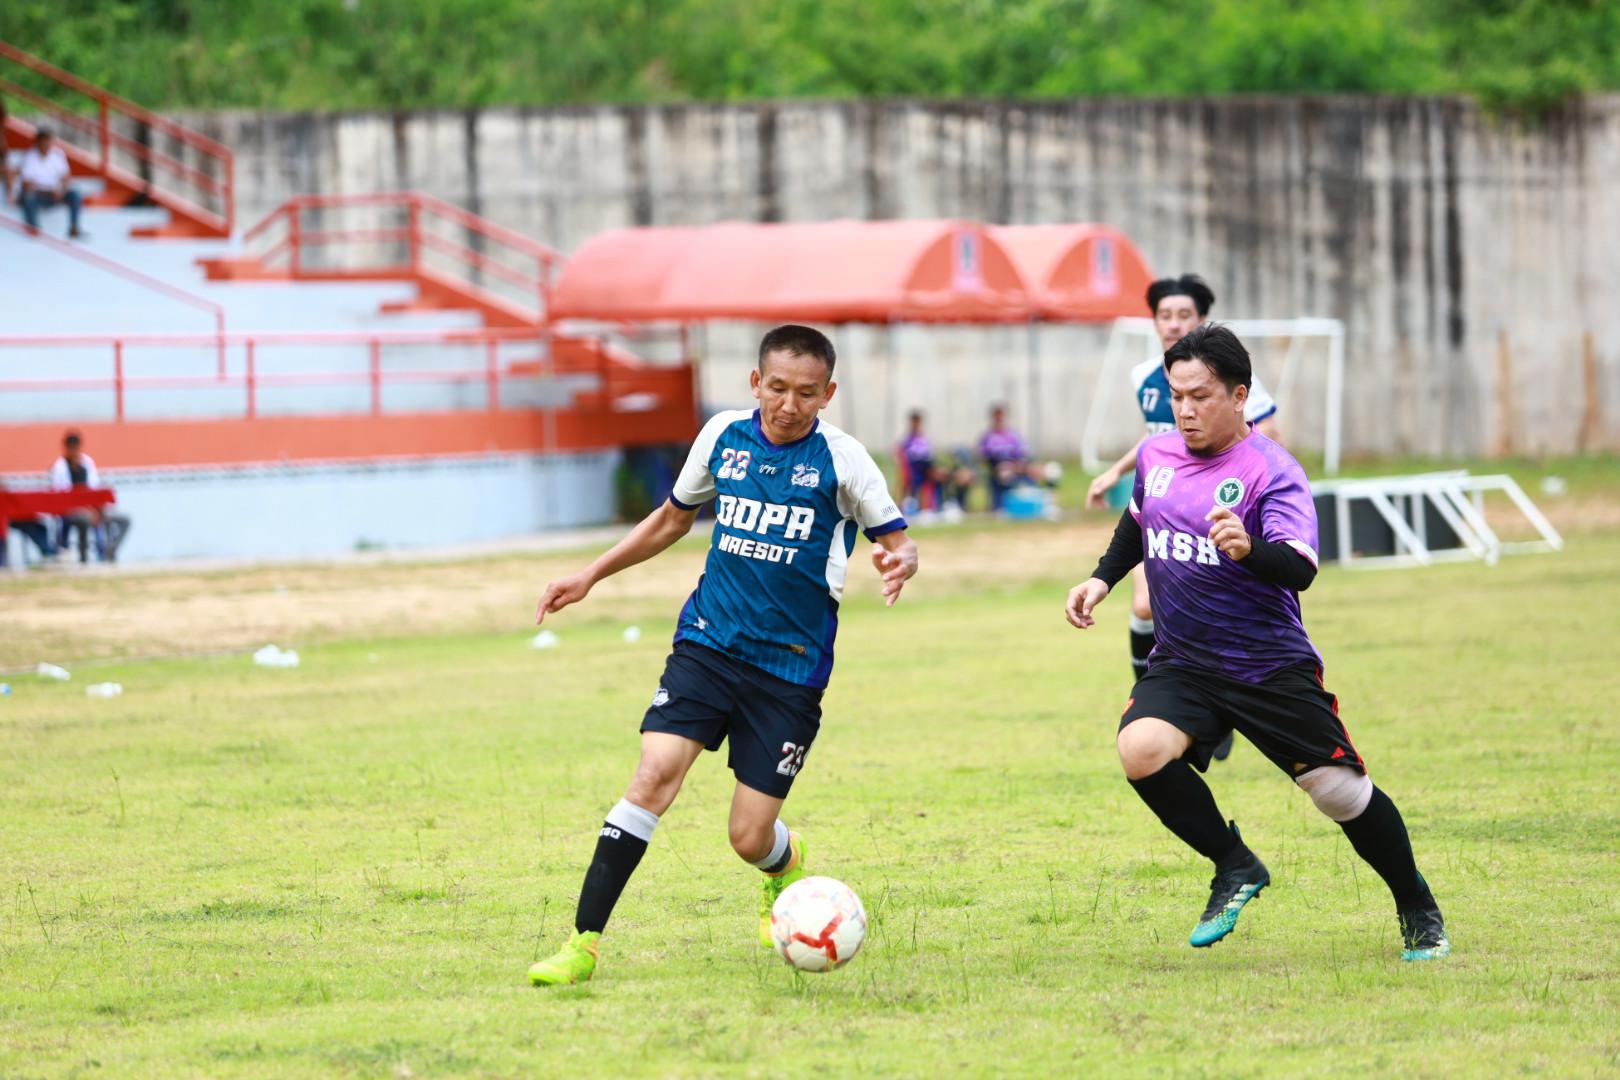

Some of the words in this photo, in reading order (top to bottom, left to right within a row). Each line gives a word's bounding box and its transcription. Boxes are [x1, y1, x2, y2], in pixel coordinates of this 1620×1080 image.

[1143, 387, 1160, 411] 17
[717, 448, 751, 481] 23
[718, 533, 799, 565] MAESOT
